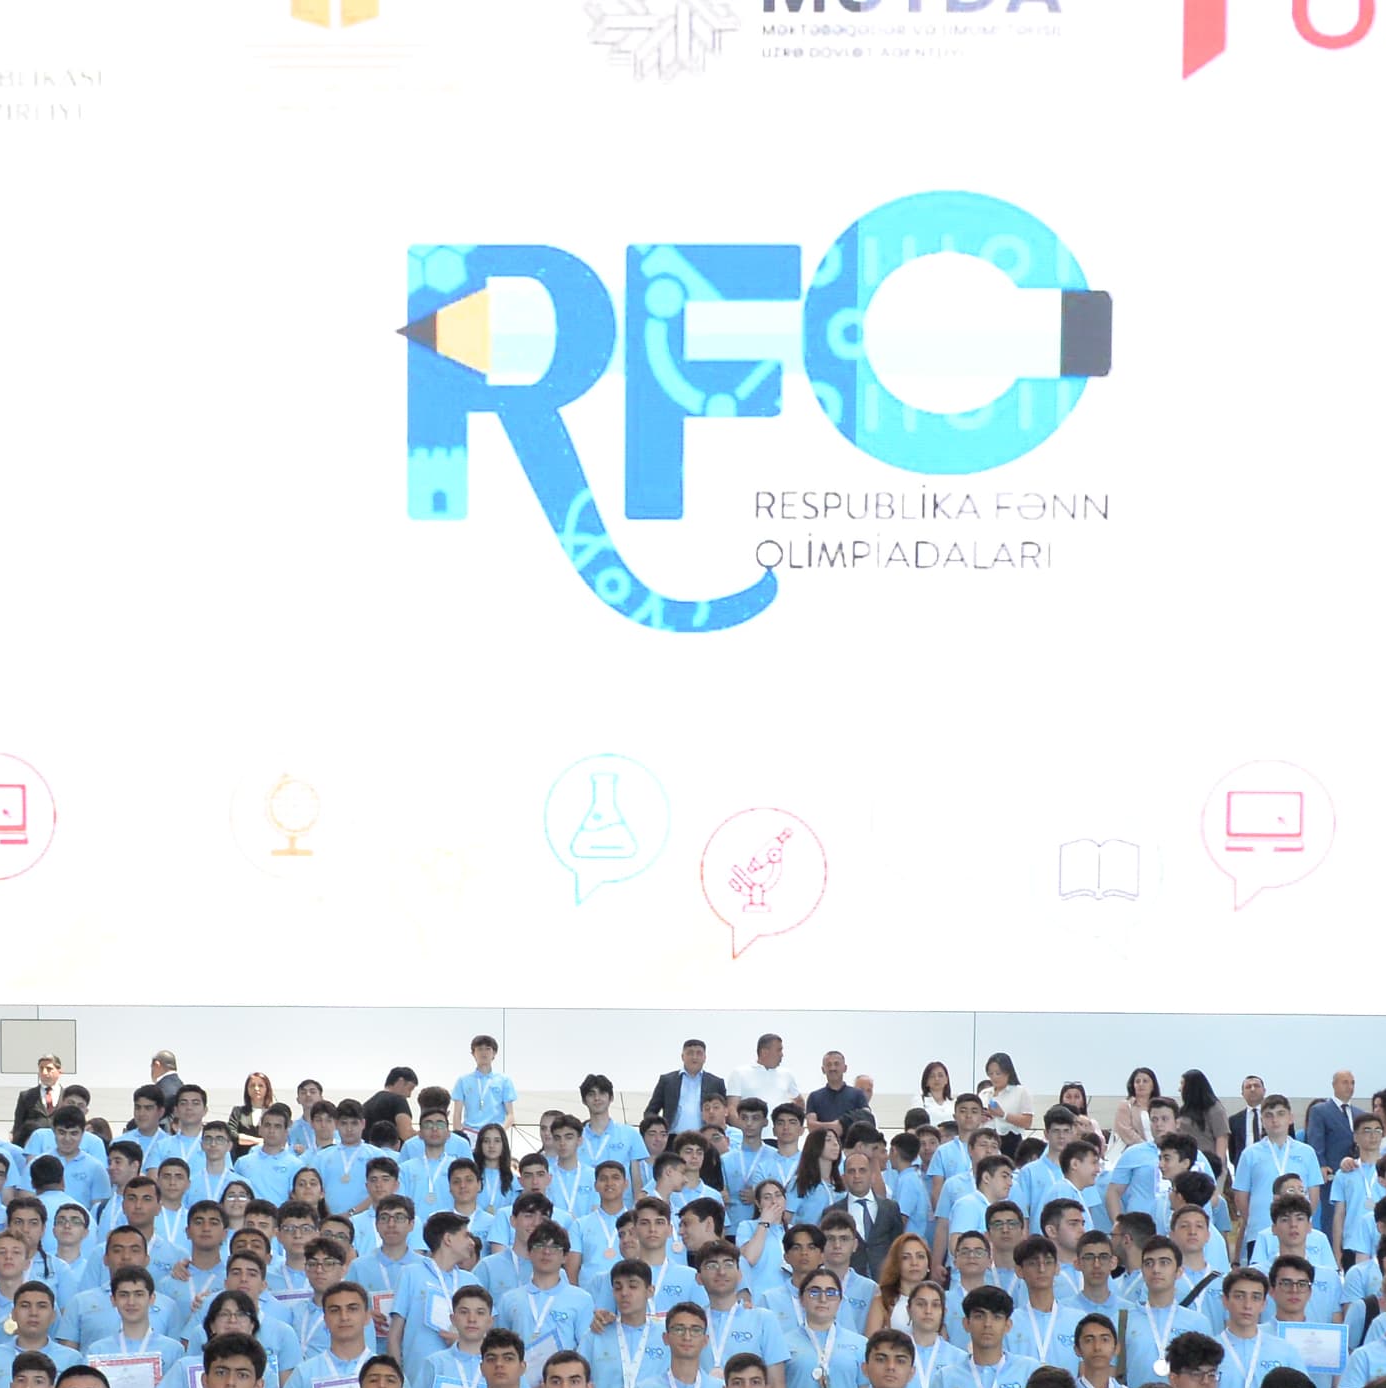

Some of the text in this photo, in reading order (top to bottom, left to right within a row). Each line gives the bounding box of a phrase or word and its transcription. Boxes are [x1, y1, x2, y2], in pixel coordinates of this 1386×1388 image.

[397, 190, 1111, 632] RFO
[755, 484, 1109, 521] RESPUBLİKA FƏNN
[755, 533, 1052, 570] OLİMPİADALARI
